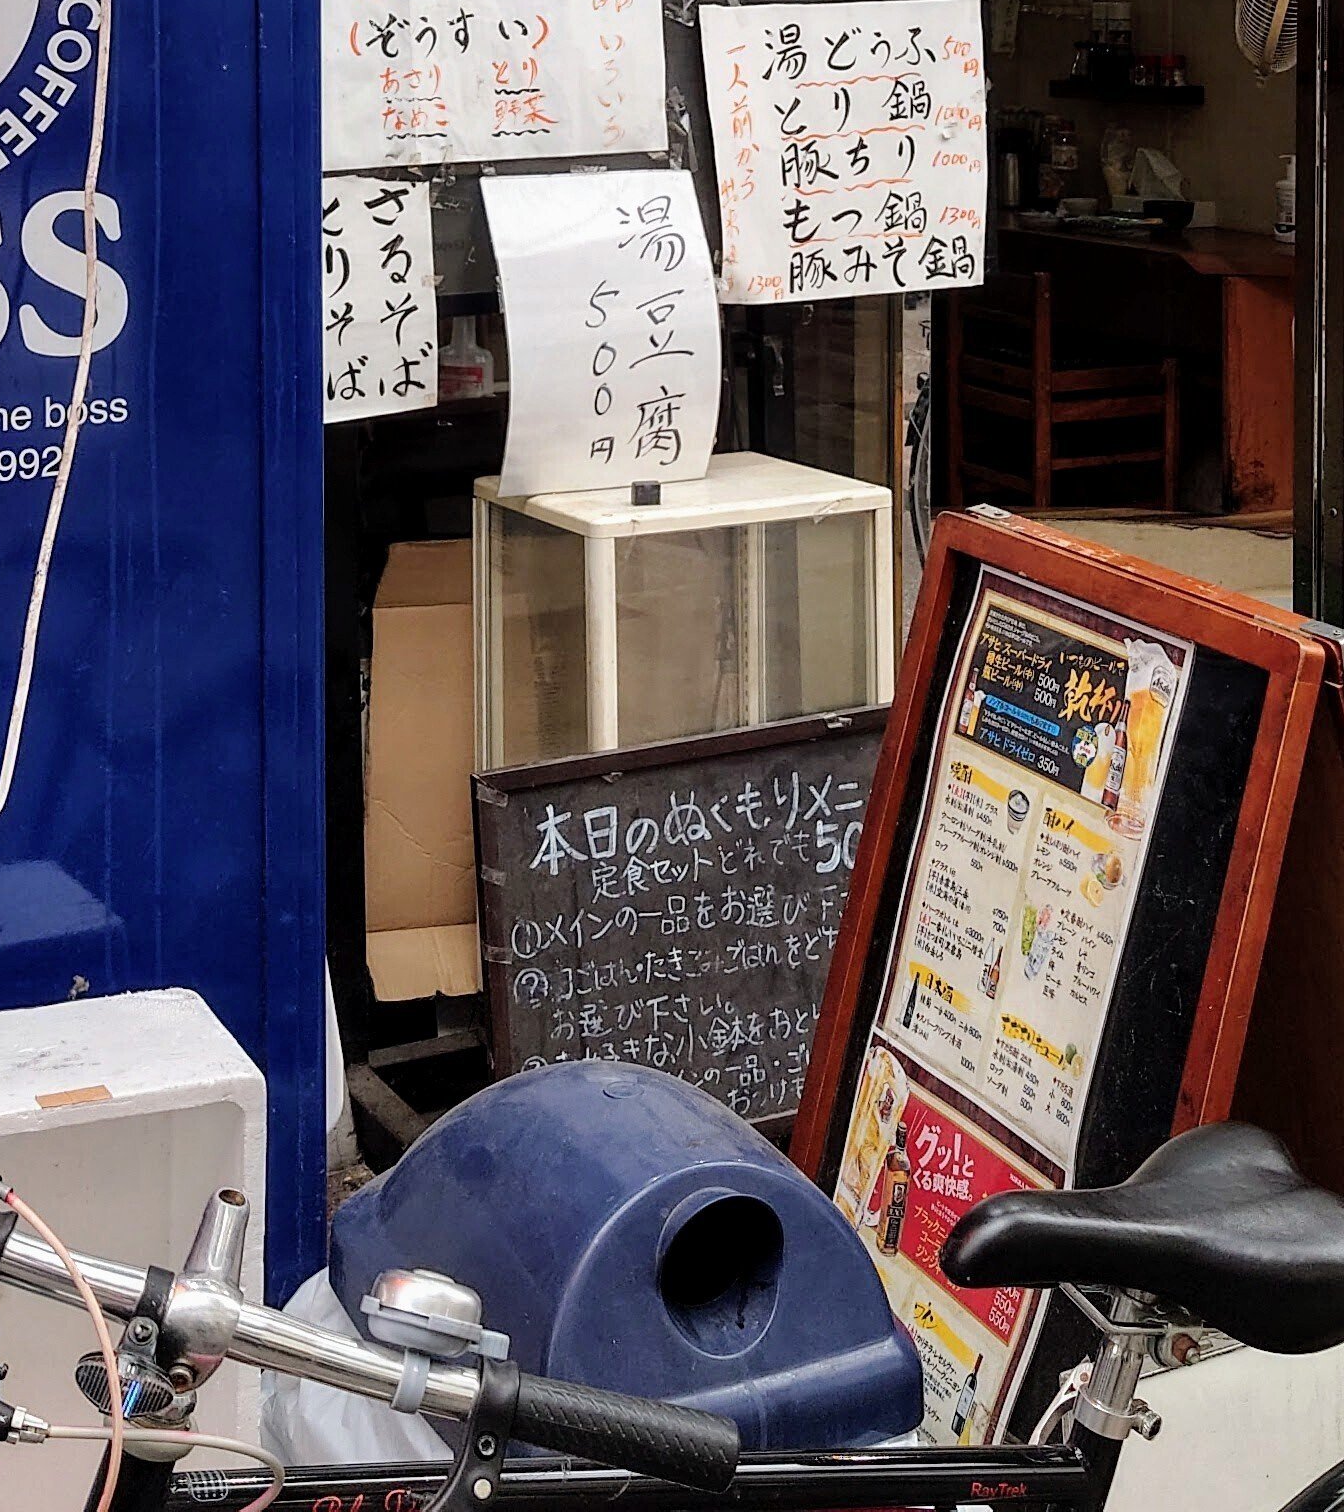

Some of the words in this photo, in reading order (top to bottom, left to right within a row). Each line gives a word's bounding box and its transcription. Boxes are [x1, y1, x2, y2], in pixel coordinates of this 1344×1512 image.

[348, 7, 550, 58] (ぞうすい)
[762, 22, 937, 81] 湯どうふ
[380, 68, 442, 94] あさり
[774, 80, 934, 137] とり鍋
[781, 134, 917, 188] 豚ちり
[782, 190, 928, 245] もつ鍋
[938, 204, 982, 231] 1300円
[364, 182, 434, 398] ざるそば
[745, 275, 785, 301] 1300円
[789, 235, 977, 294] 豚みそ鍋
[322, 197, 370, 404] とりそば
[616, 194, 695, 466] 湯豆腐
[585, 279, 620, 465] 500円
[44, 396, 128, 429] boss
[1033, 688, 1057, 707] 500円
[1037, 673, 1061, 693] 500円
[1037, 755, 1060, 777] 350円
[988, 1310, 1010, 1335] 550円
[971, 1482, 1027, 1497] RayTrek
